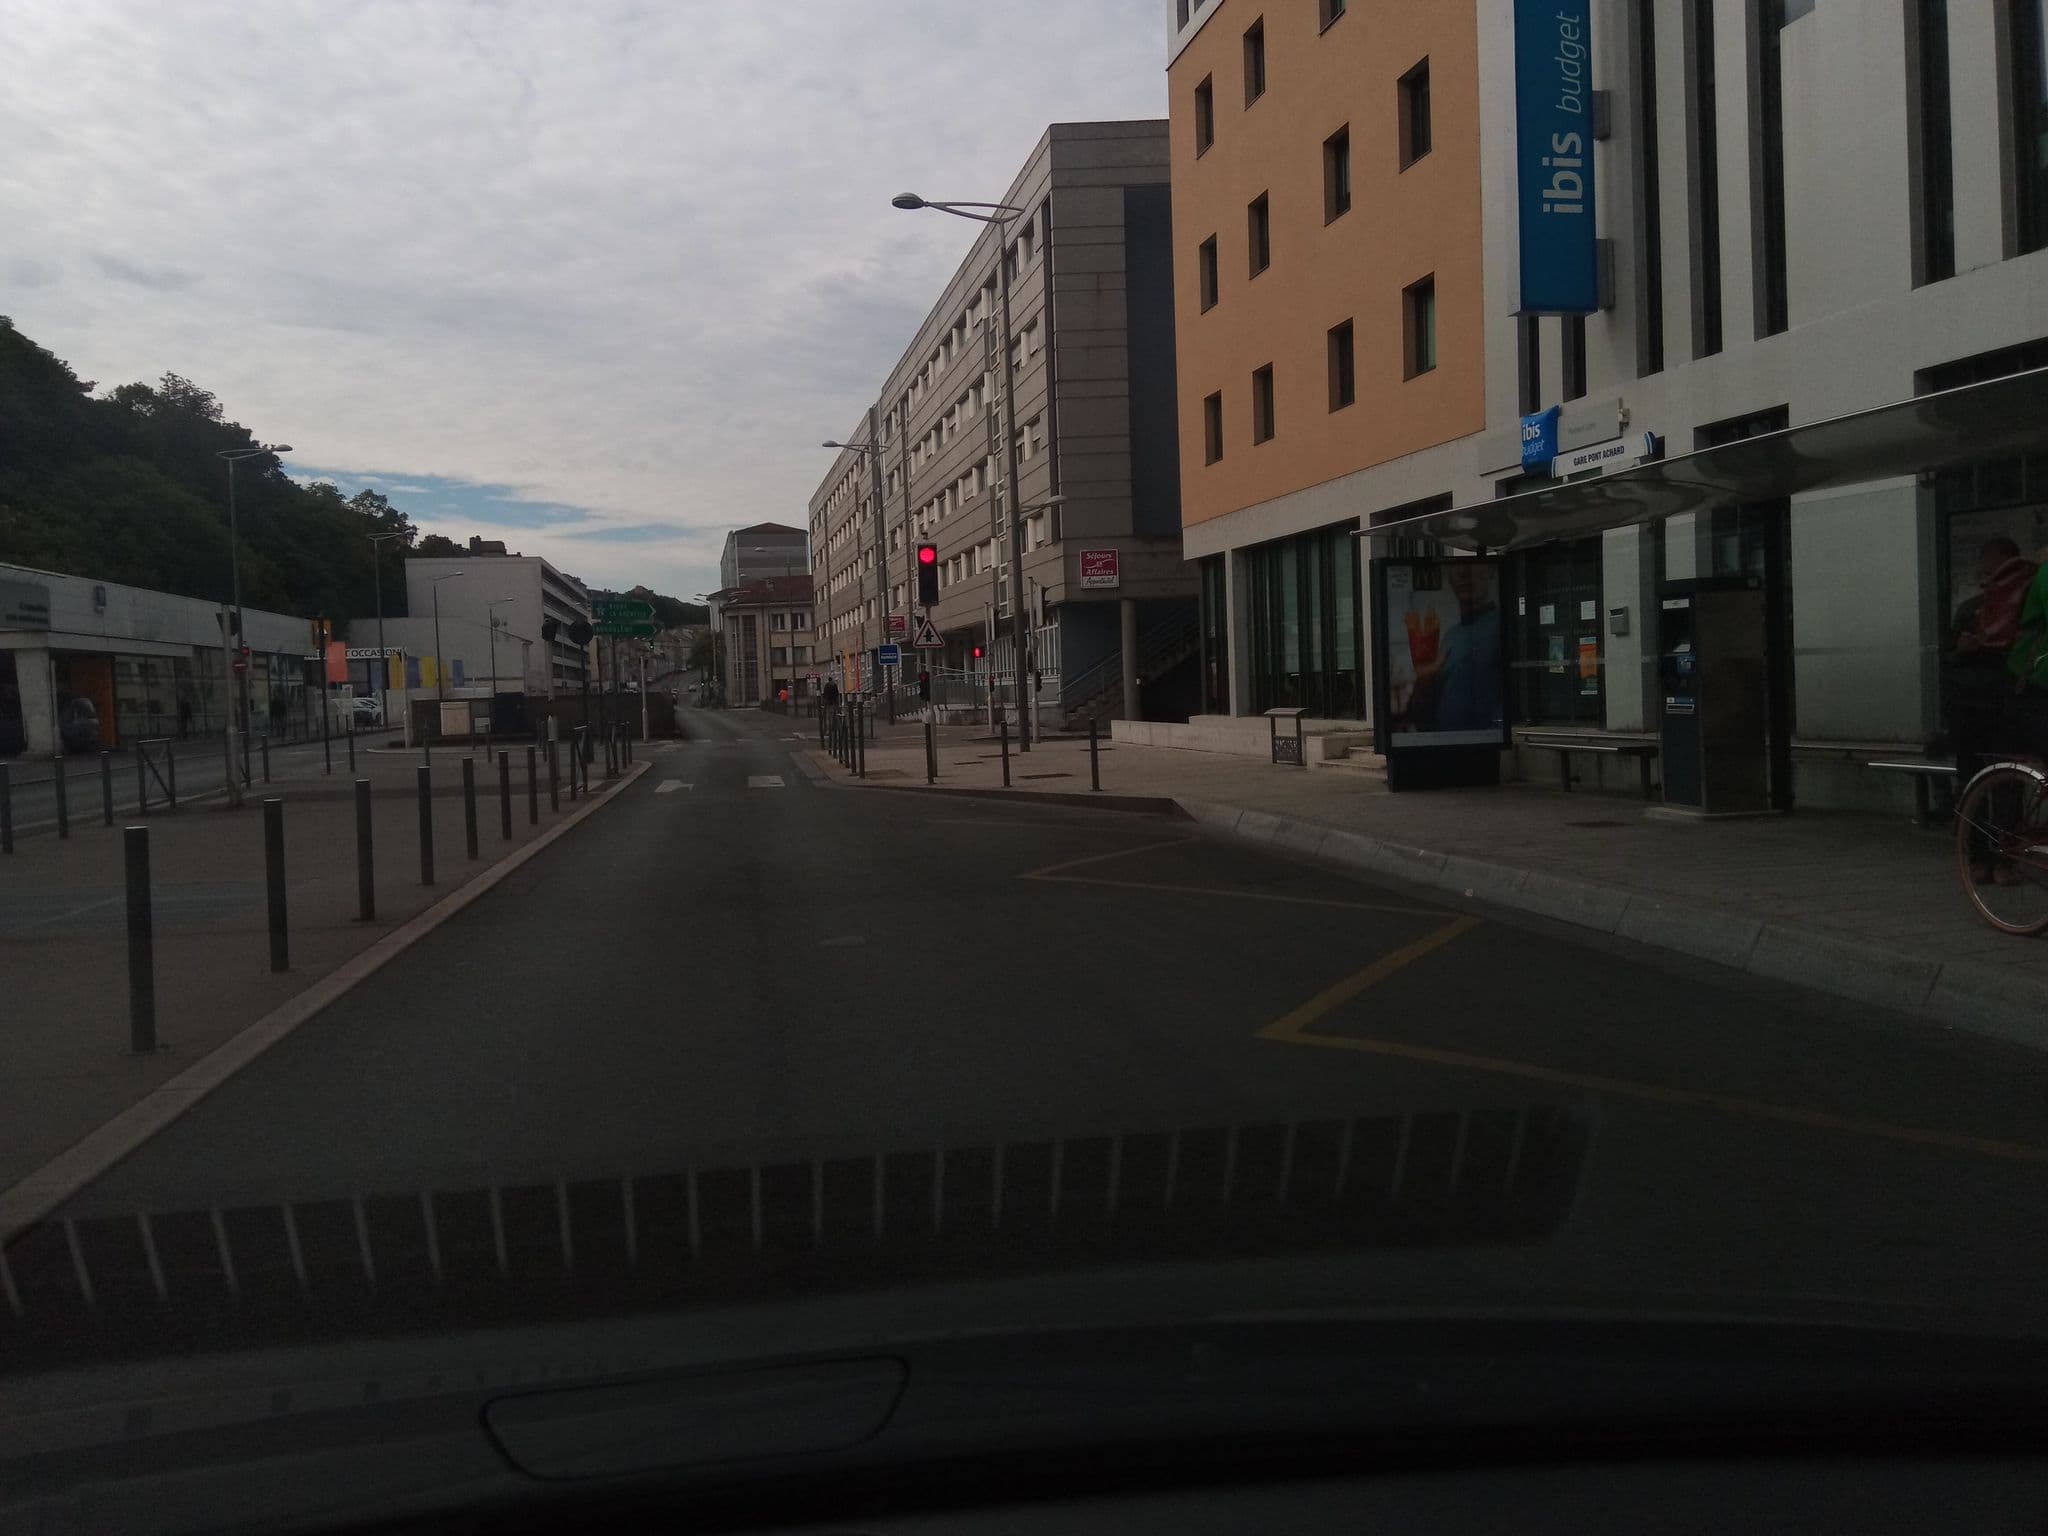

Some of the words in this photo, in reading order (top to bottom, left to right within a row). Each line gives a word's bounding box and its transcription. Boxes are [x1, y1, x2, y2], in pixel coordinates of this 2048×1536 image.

[1554, 10, 1586, 114] budget
[1541, 131, 1584, 214] ibis
[1522, 422, 1541, 441] ibis
[1573, 455, 1588, 466] GARE
[1588, 451, 1602, 463] PONT
[1602, 445, 1625, 460] ACHARD
